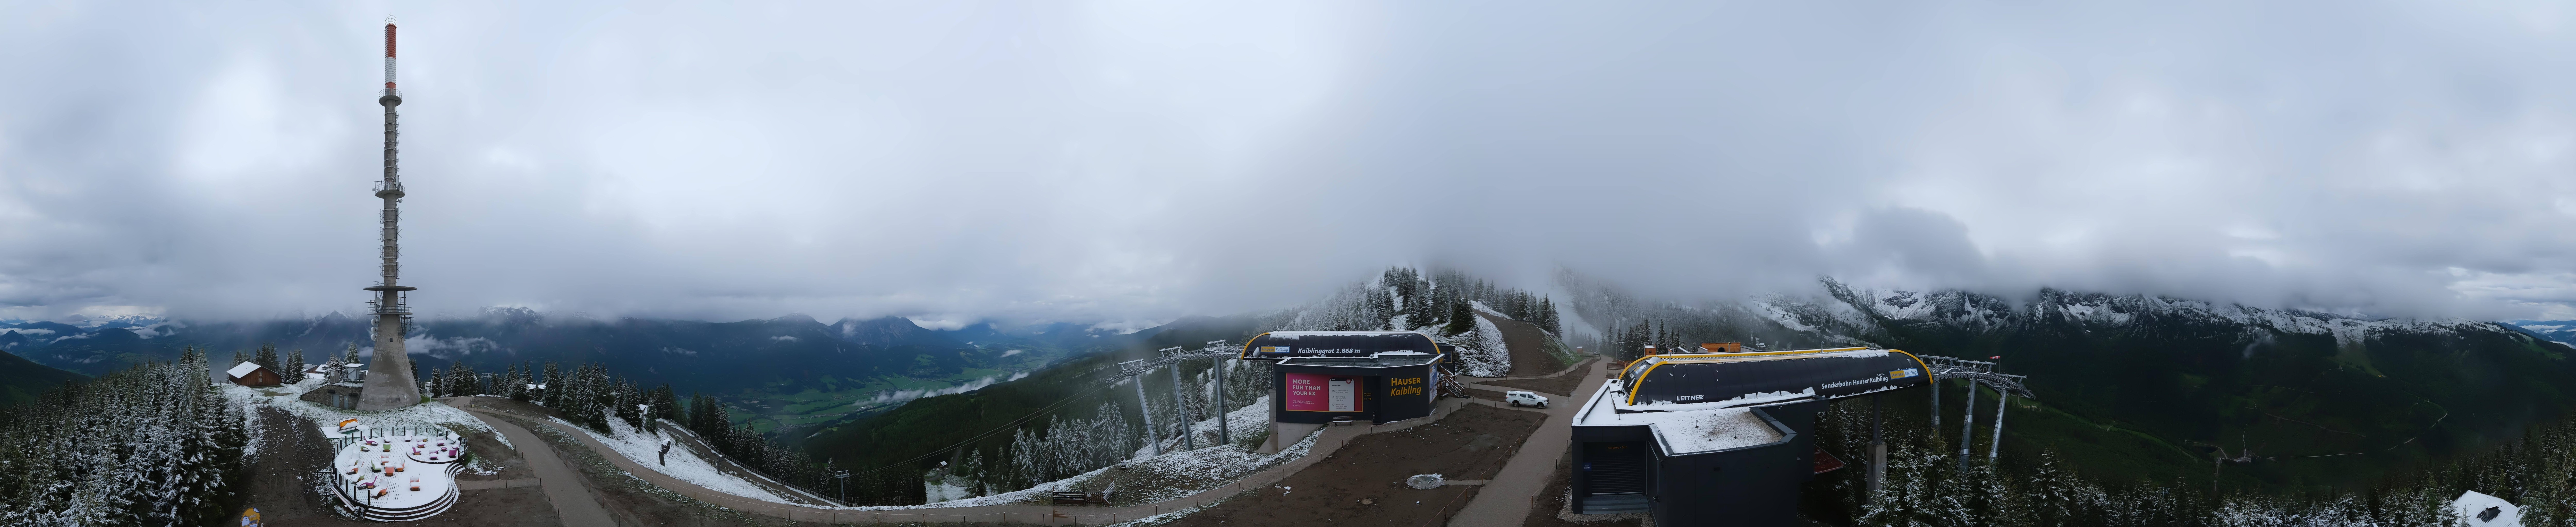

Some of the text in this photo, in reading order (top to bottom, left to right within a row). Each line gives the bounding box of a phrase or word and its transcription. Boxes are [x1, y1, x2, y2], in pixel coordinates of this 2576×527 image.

[1391, 378, 1421, 386] HAUSER
[1821, 380, 1852, 389] Senderbahn
[1391, 386, 1421, 396] Kaibling
